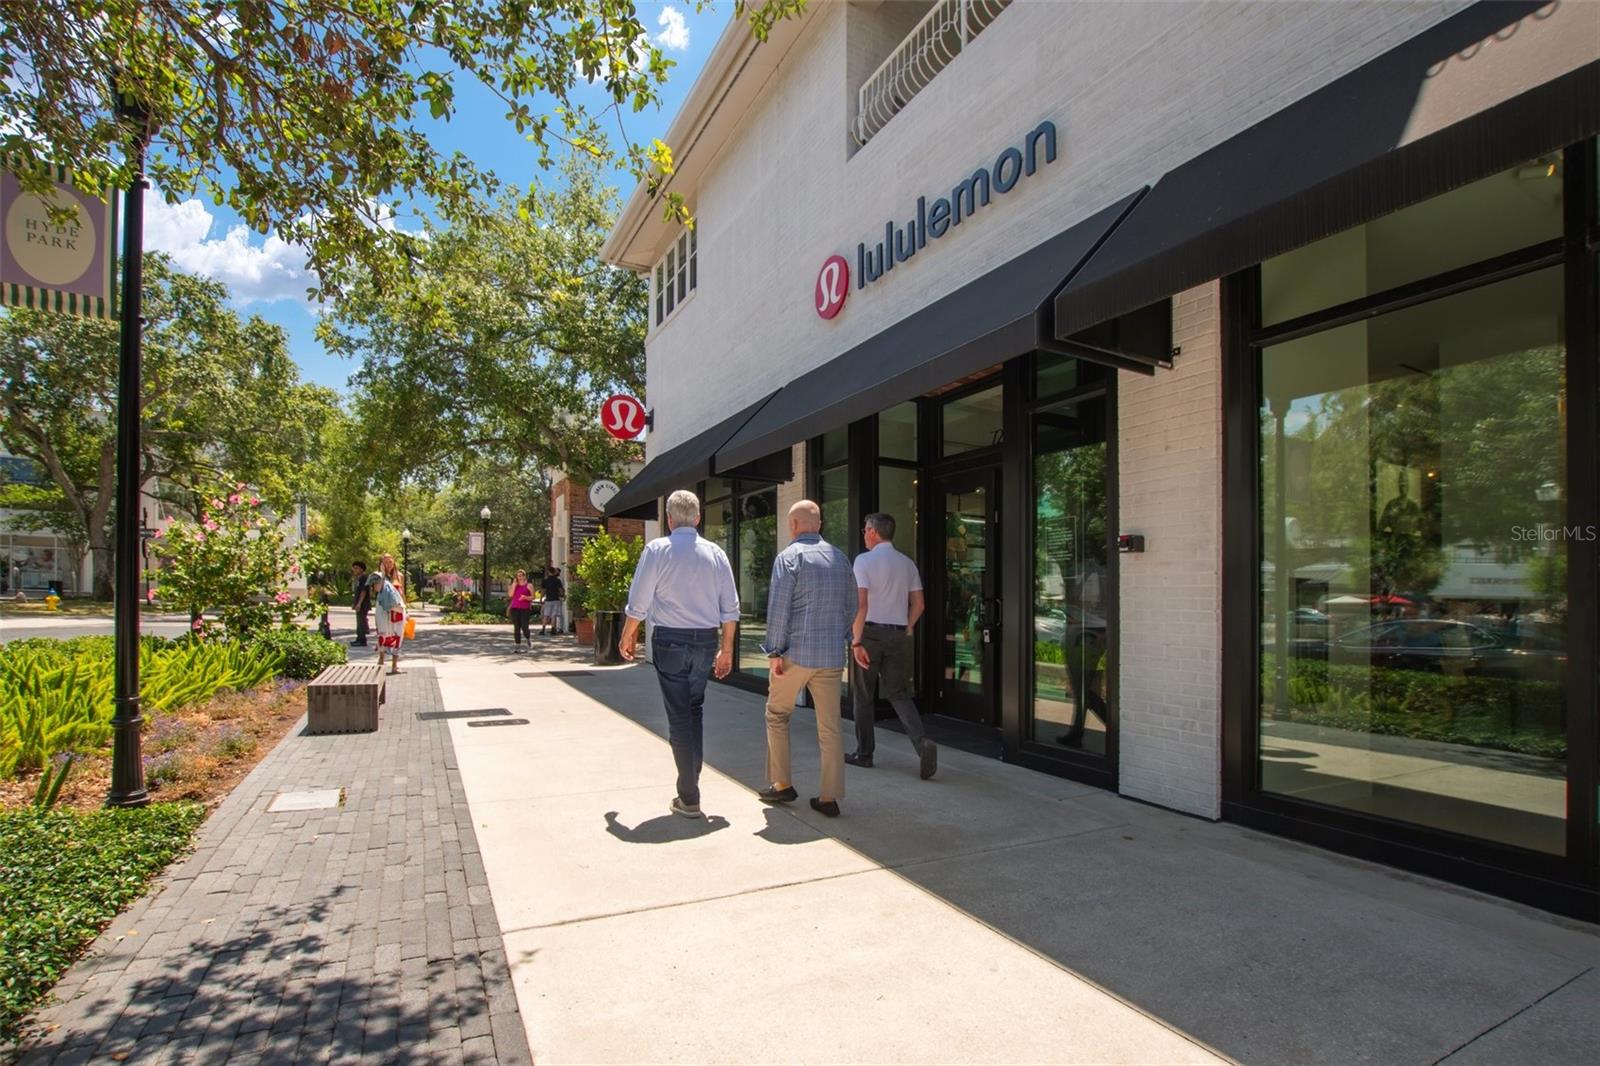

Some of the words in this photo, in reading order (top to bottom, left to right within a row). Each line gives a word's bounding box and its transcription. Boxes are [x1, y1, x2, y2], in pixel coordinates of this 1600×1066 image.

[857, 120, 1057, 290] lululemon
[26, 218, 79, 237] HYDE
[27, 232, 77, 250] PARK
